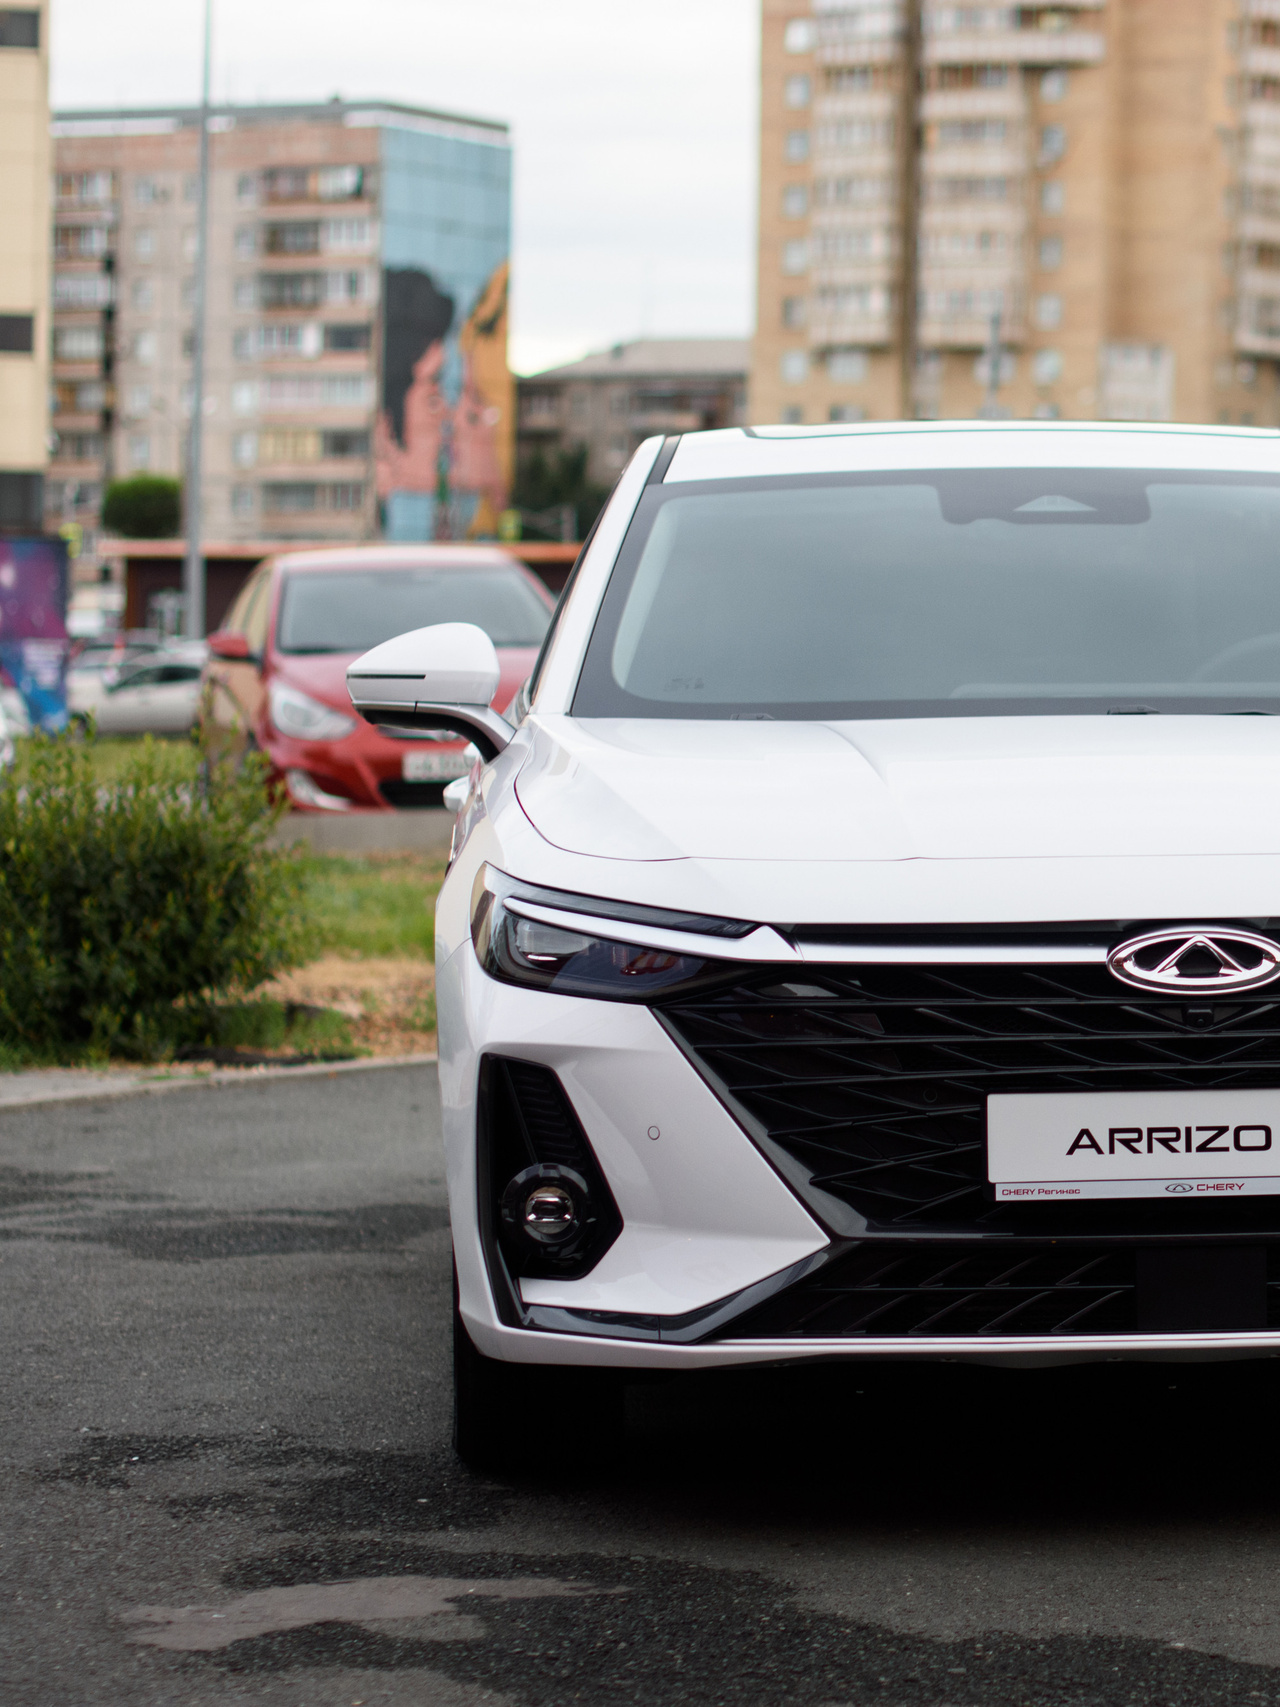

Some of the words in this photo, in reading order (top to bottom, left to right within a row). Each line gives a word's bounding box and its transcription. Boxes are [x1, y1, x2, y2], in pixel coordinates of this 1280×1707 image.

[1065, 1124, 1272, 1155] ARRIZO
[1196, 1182, 1245, 1191] CHERY
[1001, 1188, 1036, 1196] CHERY
